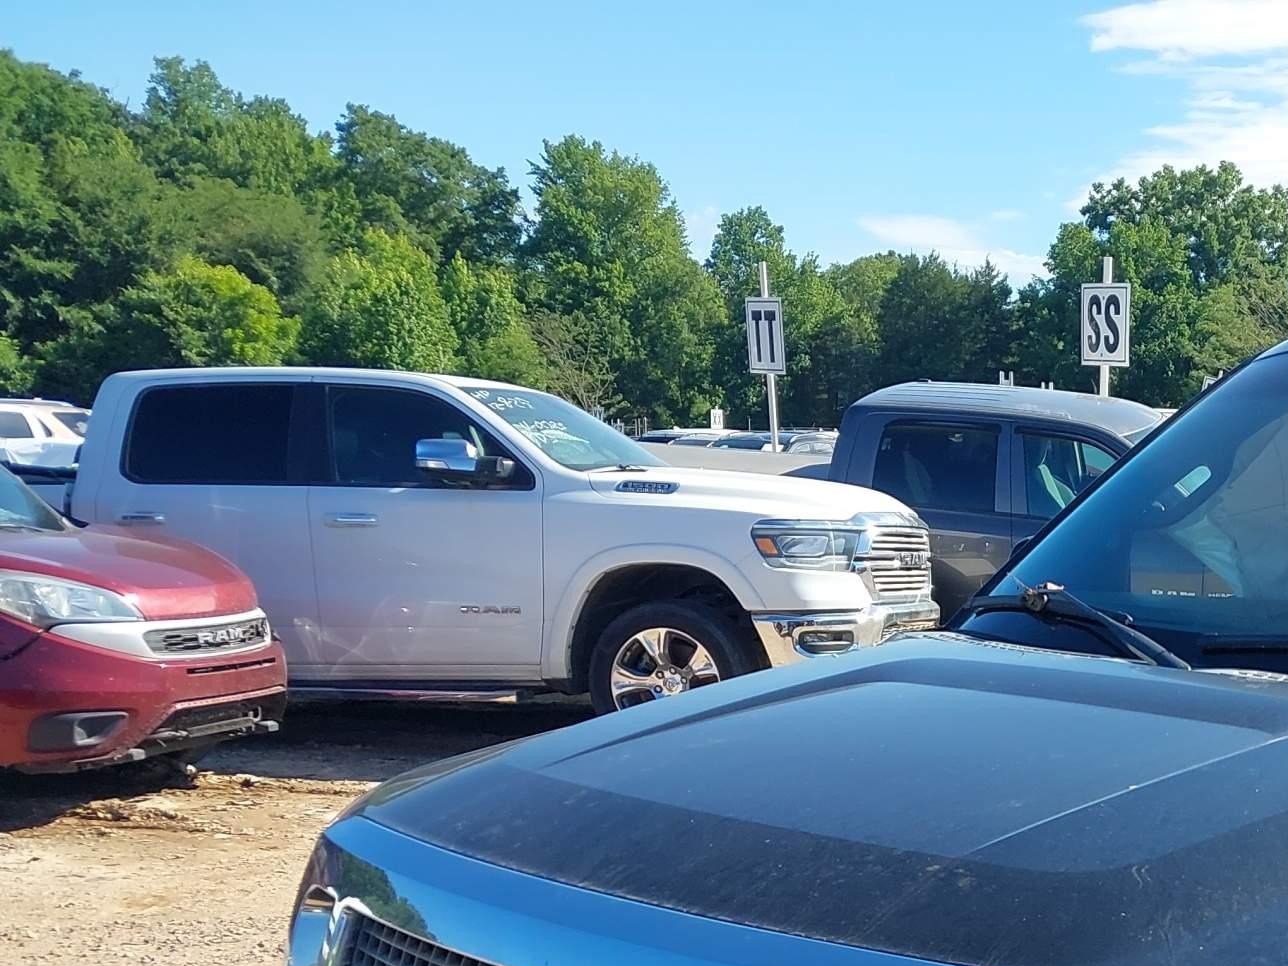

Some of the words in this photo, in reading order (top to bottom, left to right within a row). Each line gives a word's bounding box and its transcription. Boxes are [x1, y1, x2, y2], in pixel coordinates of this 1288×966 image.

[751, 310, 776, 363] TT
[1087, 294, 1120, 354] SS
[198, 627, 248, 643] RAM
